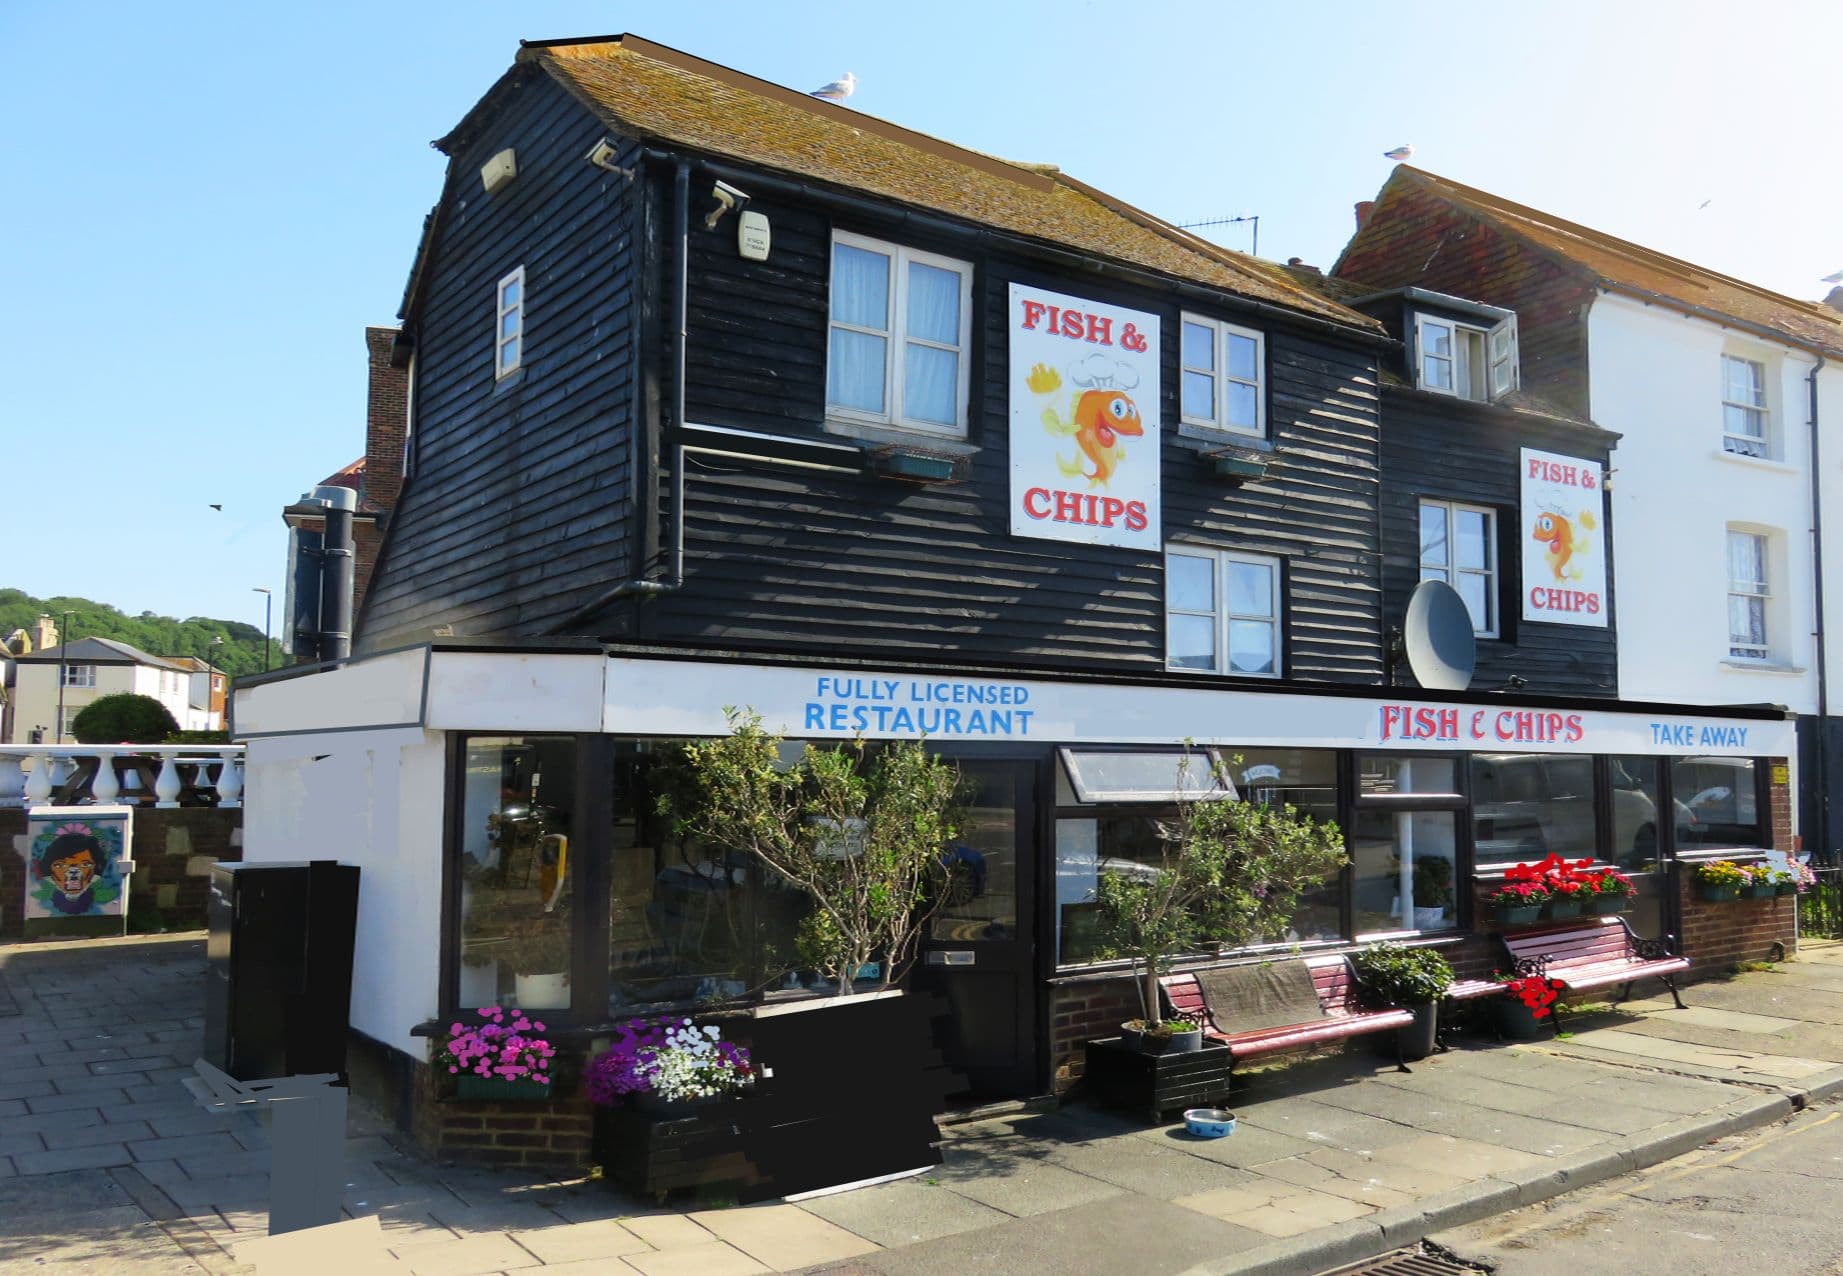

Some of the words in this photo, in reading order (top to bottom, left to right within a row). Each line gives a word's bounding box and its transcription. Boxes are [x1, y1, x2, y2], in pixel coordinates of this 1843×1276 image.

[1021, 300, 1114, 346] FISH
[1119, 322, 1148, 353] &
[1528, 459, 1578, 487] FISH
[1581, 469, 1596, 490] &
[1023, 487, 1148, 532] CHIPS
[1530, 586, 1600, 614] CHIPS
[817, 677, 900, 701] FULLY
[911, 682, 1029, 705] LICENSED
[804, 703, 1034, 735] RESTAURANT
[1379, 705, 1459, 744] FISH
[1495, 710, 1584, 743] CHIPS
[1651, 723, 1694, 746] TAKE
[1700, 727, 1748, 747] AWAY
